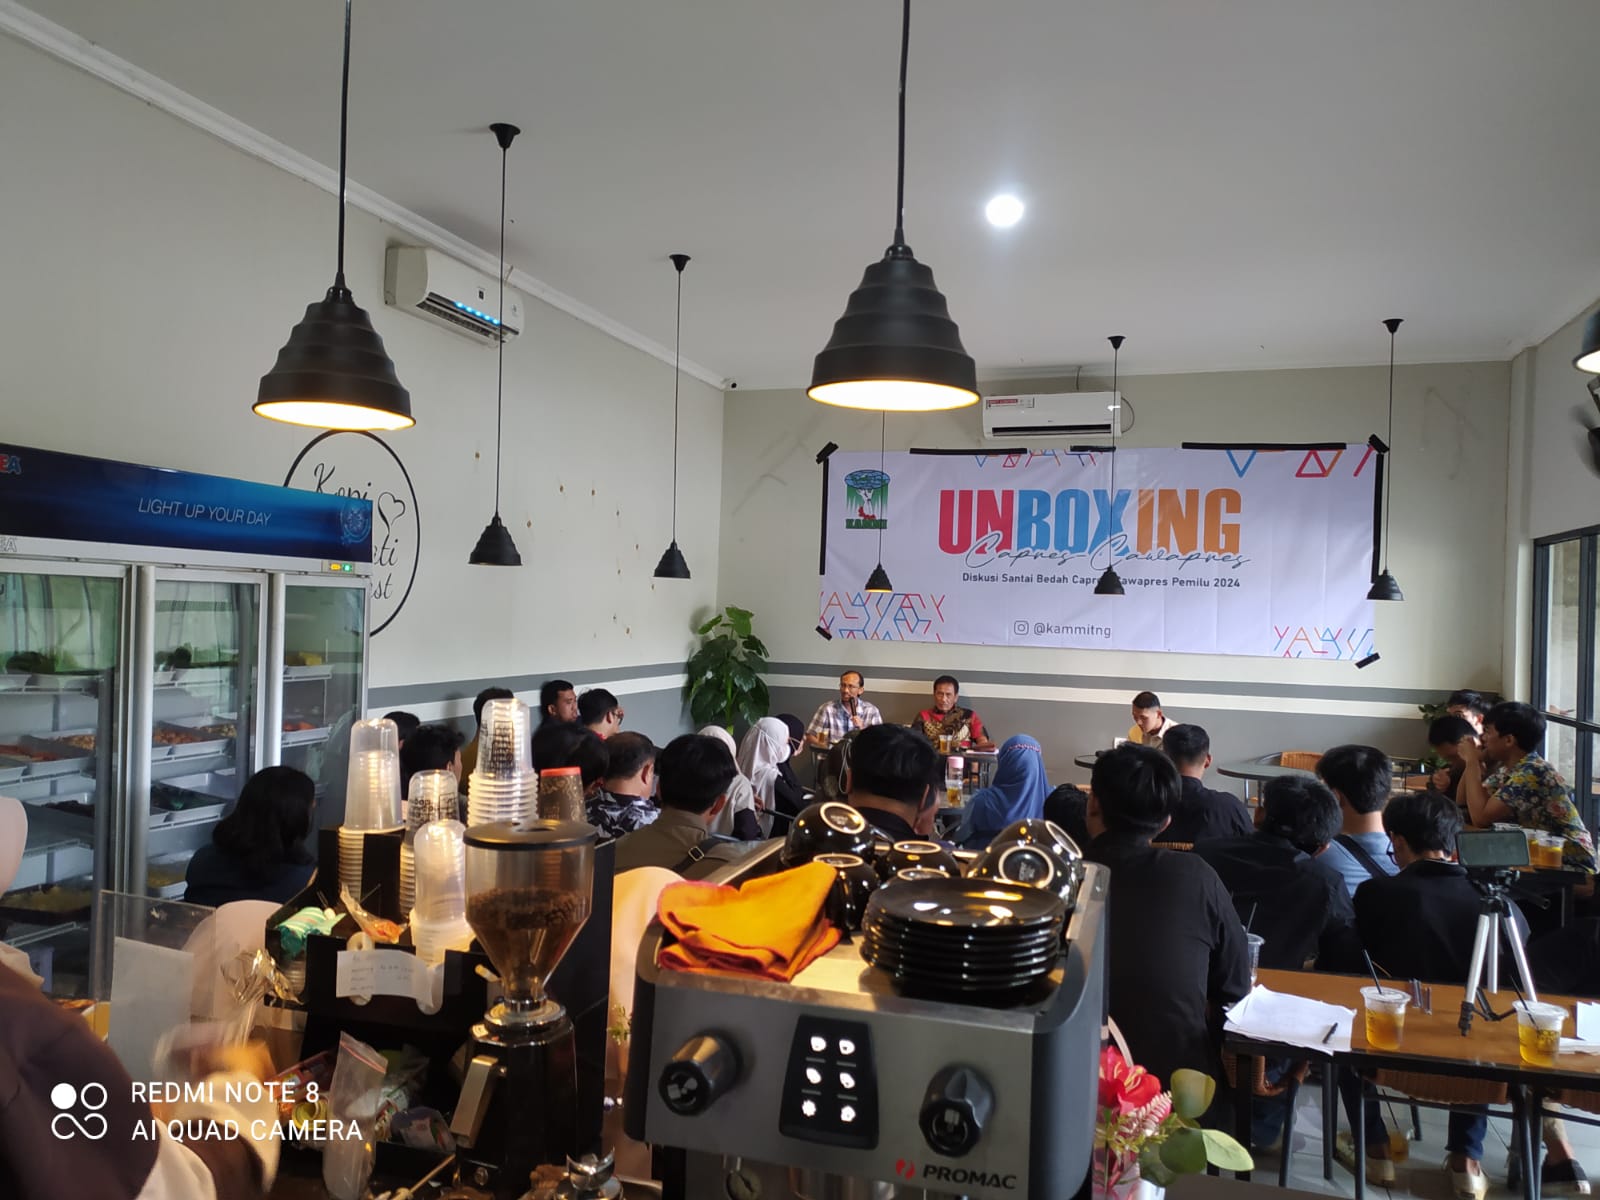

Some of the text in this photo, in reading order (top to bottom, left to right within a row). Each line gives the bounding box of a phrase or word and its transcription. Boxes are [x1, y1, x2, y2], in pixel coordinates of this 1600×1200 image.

[138, 497, 272, 526] LIGHT UP YOUR DAY
[938, 488, 1242, 556] UNBOXING
[962, 571, 999, 583] Diskusi
[1001, 573, 1034, 584] Santai
[1036, 574, 1069, 585] Bedah
[1171, 576, 1210, 588] Pemilu
[1213, 578, 1241, 588] 2024
[1033, 622, 1112, 639] @kammitng
[922, 1163, 1017, 1190] PROMAC
